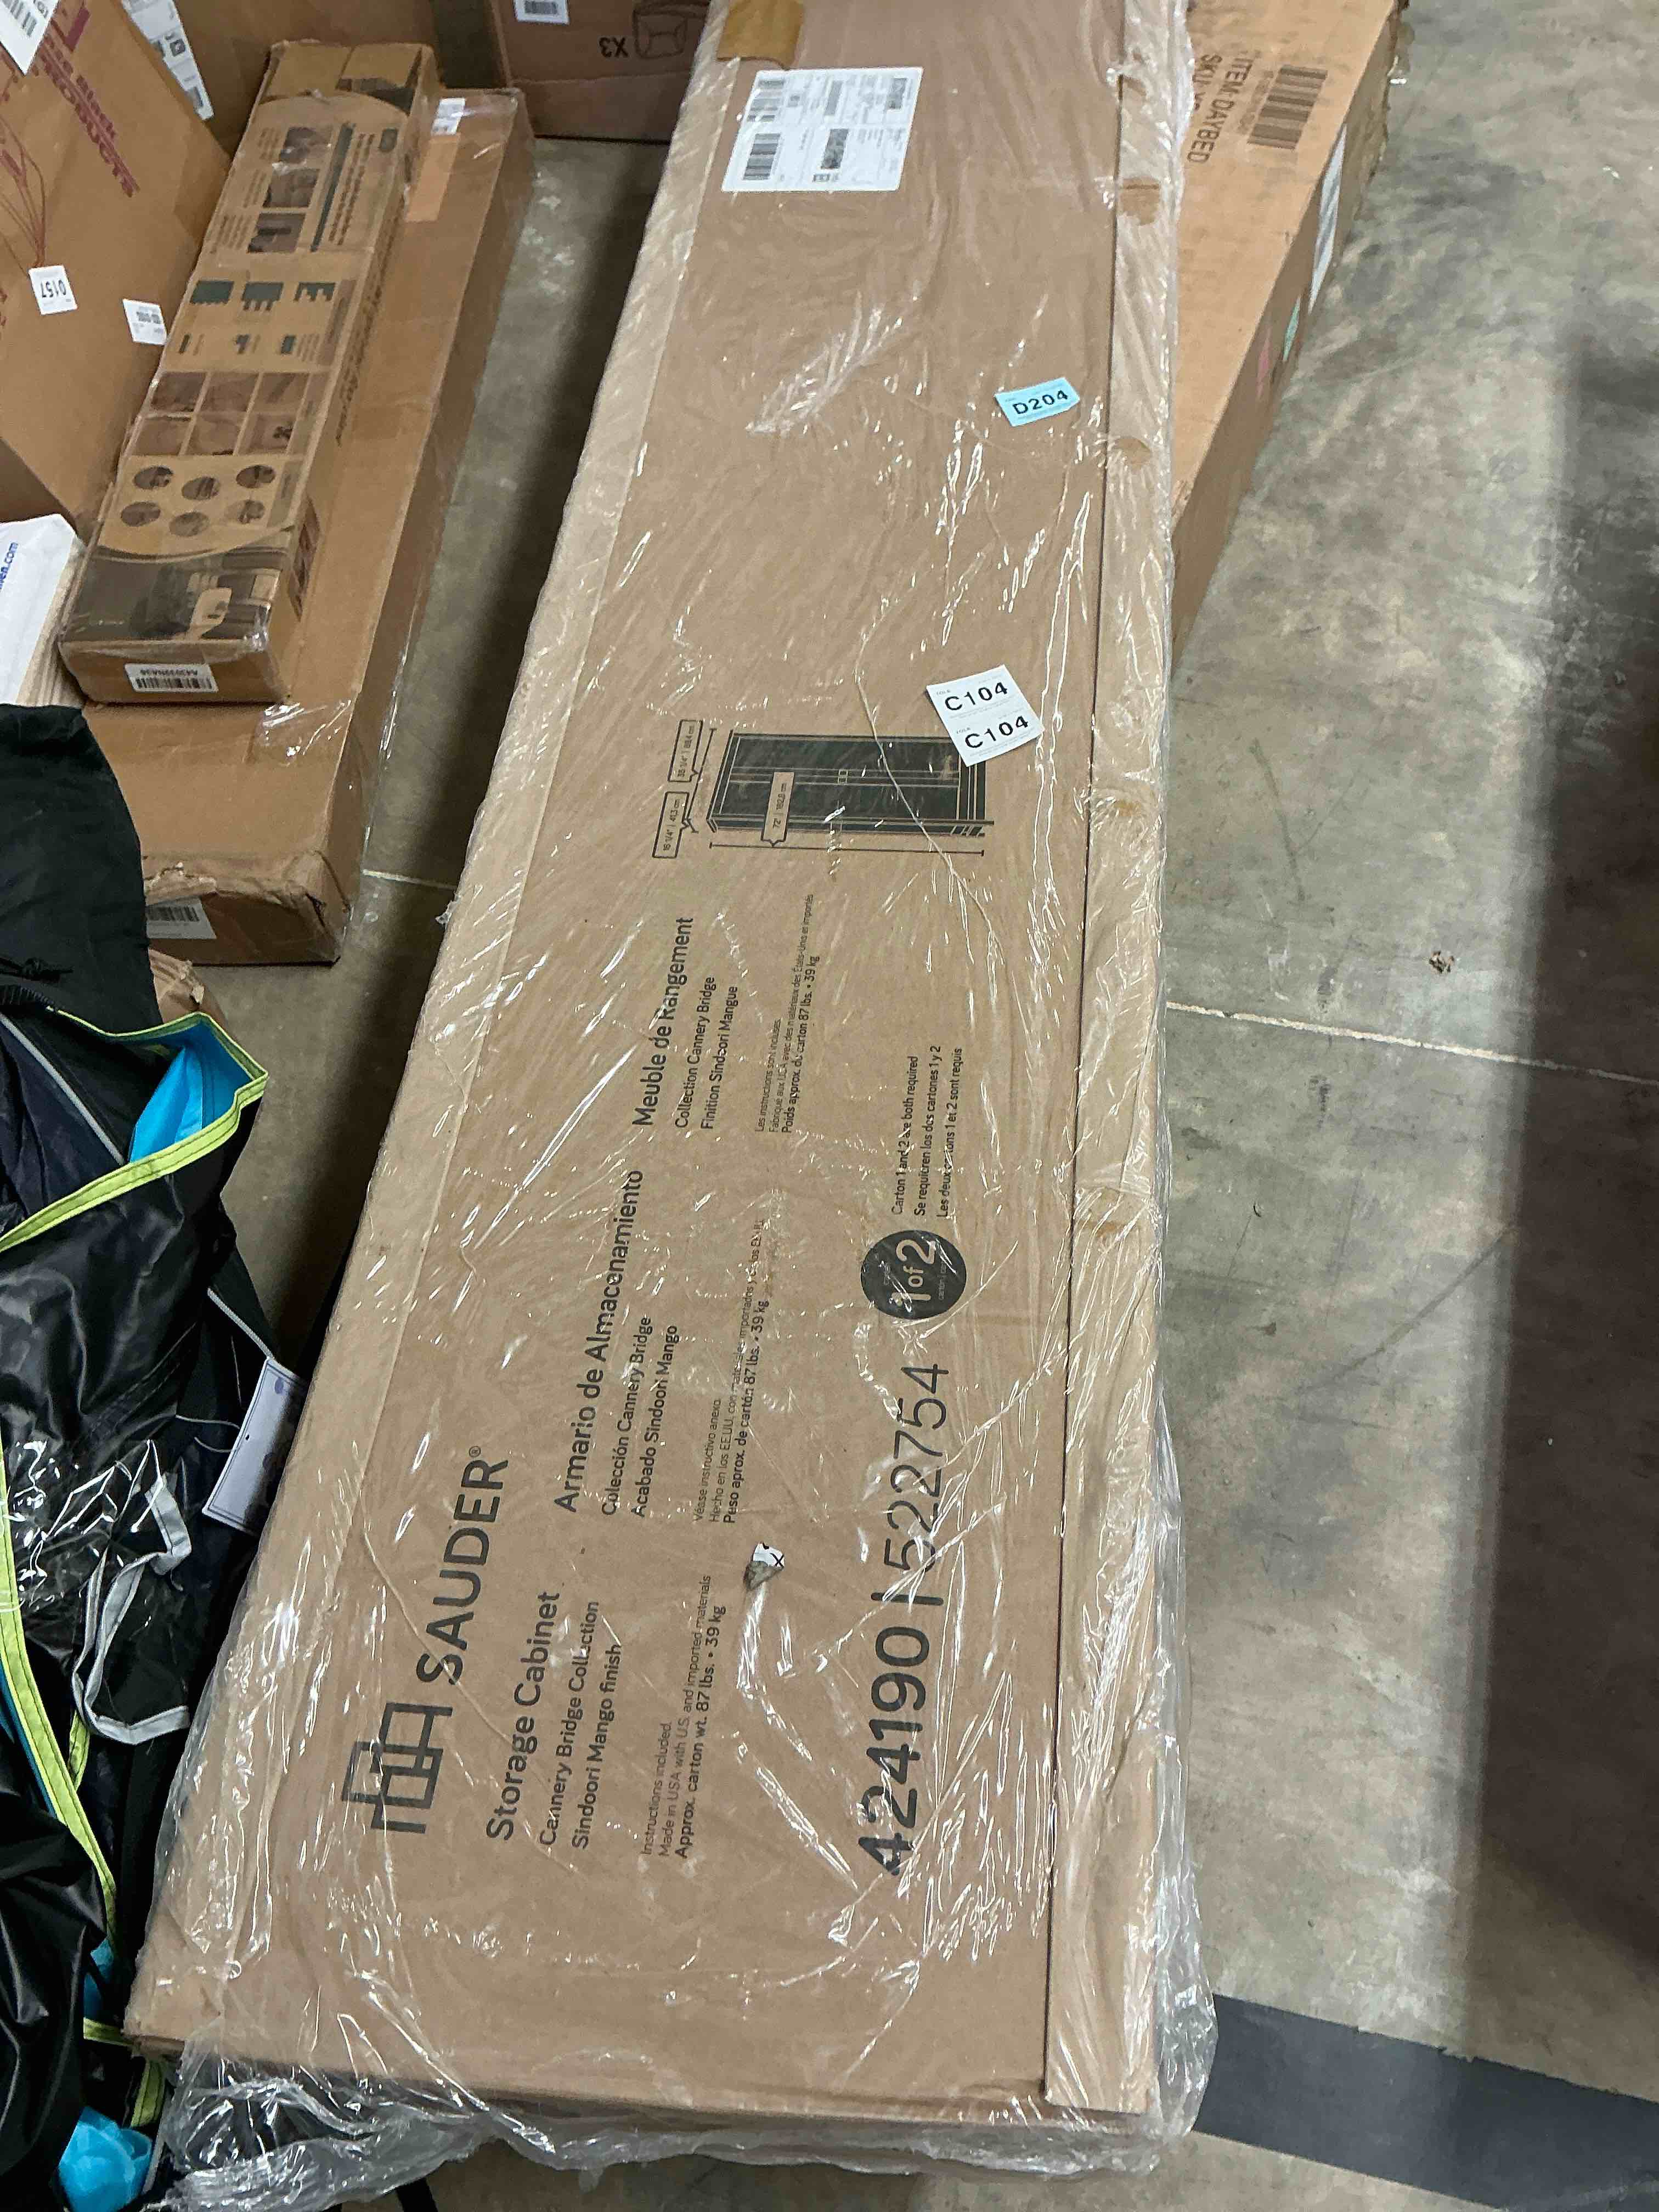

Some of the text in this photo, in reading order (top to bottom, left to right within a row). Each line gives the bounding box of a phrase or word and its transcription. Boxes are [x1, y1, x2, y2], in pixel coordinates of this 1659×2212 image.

[1012, 390, 1068, 414] D204
[945, 682, 1008, 710] C104
[964, 715, 1029, 748] C104
[791, 974, 802, 988] des
[631, 917, 693, 1126] Meuble de Rangement
[783, 1028, 793, 1041] des
[675, 977, 716, 1128] Collection Cannery Bridge
[701, 986, 738, 1129] Finition Sindoori Mangue
[766, 1052, 777, 1069] sont
[782, 956, 820, 1133] Poids approx. du carton 87 lbs. 39 kg
[782, 1042, 792, 1060] avec
[907, 1056, 919, 1095] required
[952, 1048, 963, 1077] requis
[759, 1071, 774, 1115] instructions
[775, 1082, 786, 1097] aux
[927, 1070, 939, 1111] cartones
[947, 1079, 960, 1100] sont
[755, 1118, 766, 1132] Les
[901, 1098, 915, 1120] both
[922, 1114, 935, 1132] dos
[947, 1113, 957, 1122] et
[897, 1150, 909, 1169] and
[919, 1135, 932, 1149] los
[918, 1152, 931, 1199] requieren
[939, 1173, 952, 1197] deux
[891, 1180, 906, 1215] Carton
[914, 1202, 926, 1216] Se
[936, 1199, 949, 1217] Les
[891, 1239, 936, 1306] 1 of 2
[738, 1286, 754, 1339] importados
[554, 1170, 643, 1513] Armario de Almacenamiento
[601, 1317, 653, 1516] Colección Cannery Bridge
[631, 1325, 679, 1517] Acabado Sindoori Mango
[724, 1301, 769, 1523] Peso aprox. de cartón 87 lbs. 39 kg
[727, 1395, 738, 1414] con
[701, 1433, 717, 1487] instructivo
[717, 1454, 730, 1469] los
[884, 1364, 949, 1573] 522754
[716, 1472, 726, 1485] en
[709, 1488, 725, 1523] Hecho
[693, 1575, 712, 1629] materials
[686, 1632, 704, 1686] imported
[486, 1591, 560, 1841] Storage Cabinet
[682, 1689, 695, 1713] and
[539, 1601, 599, 1846] Cannery Bridge Collection
[674, 1605, 726, 1859] Approx. carton wt. 87 lbs. 39 kg
[571, 1644, 622, 1850] Sindoori Mango finish
[673, 1741, 687, 1768] with
[857, 1626, 930, 1876] 424190
[667, 1772, 682, 1801] USA
[640, 1780, 663, 1855] Instructions
[667, 1804, 676, 1817] in
[658, 1820, 675, 1858] Made
